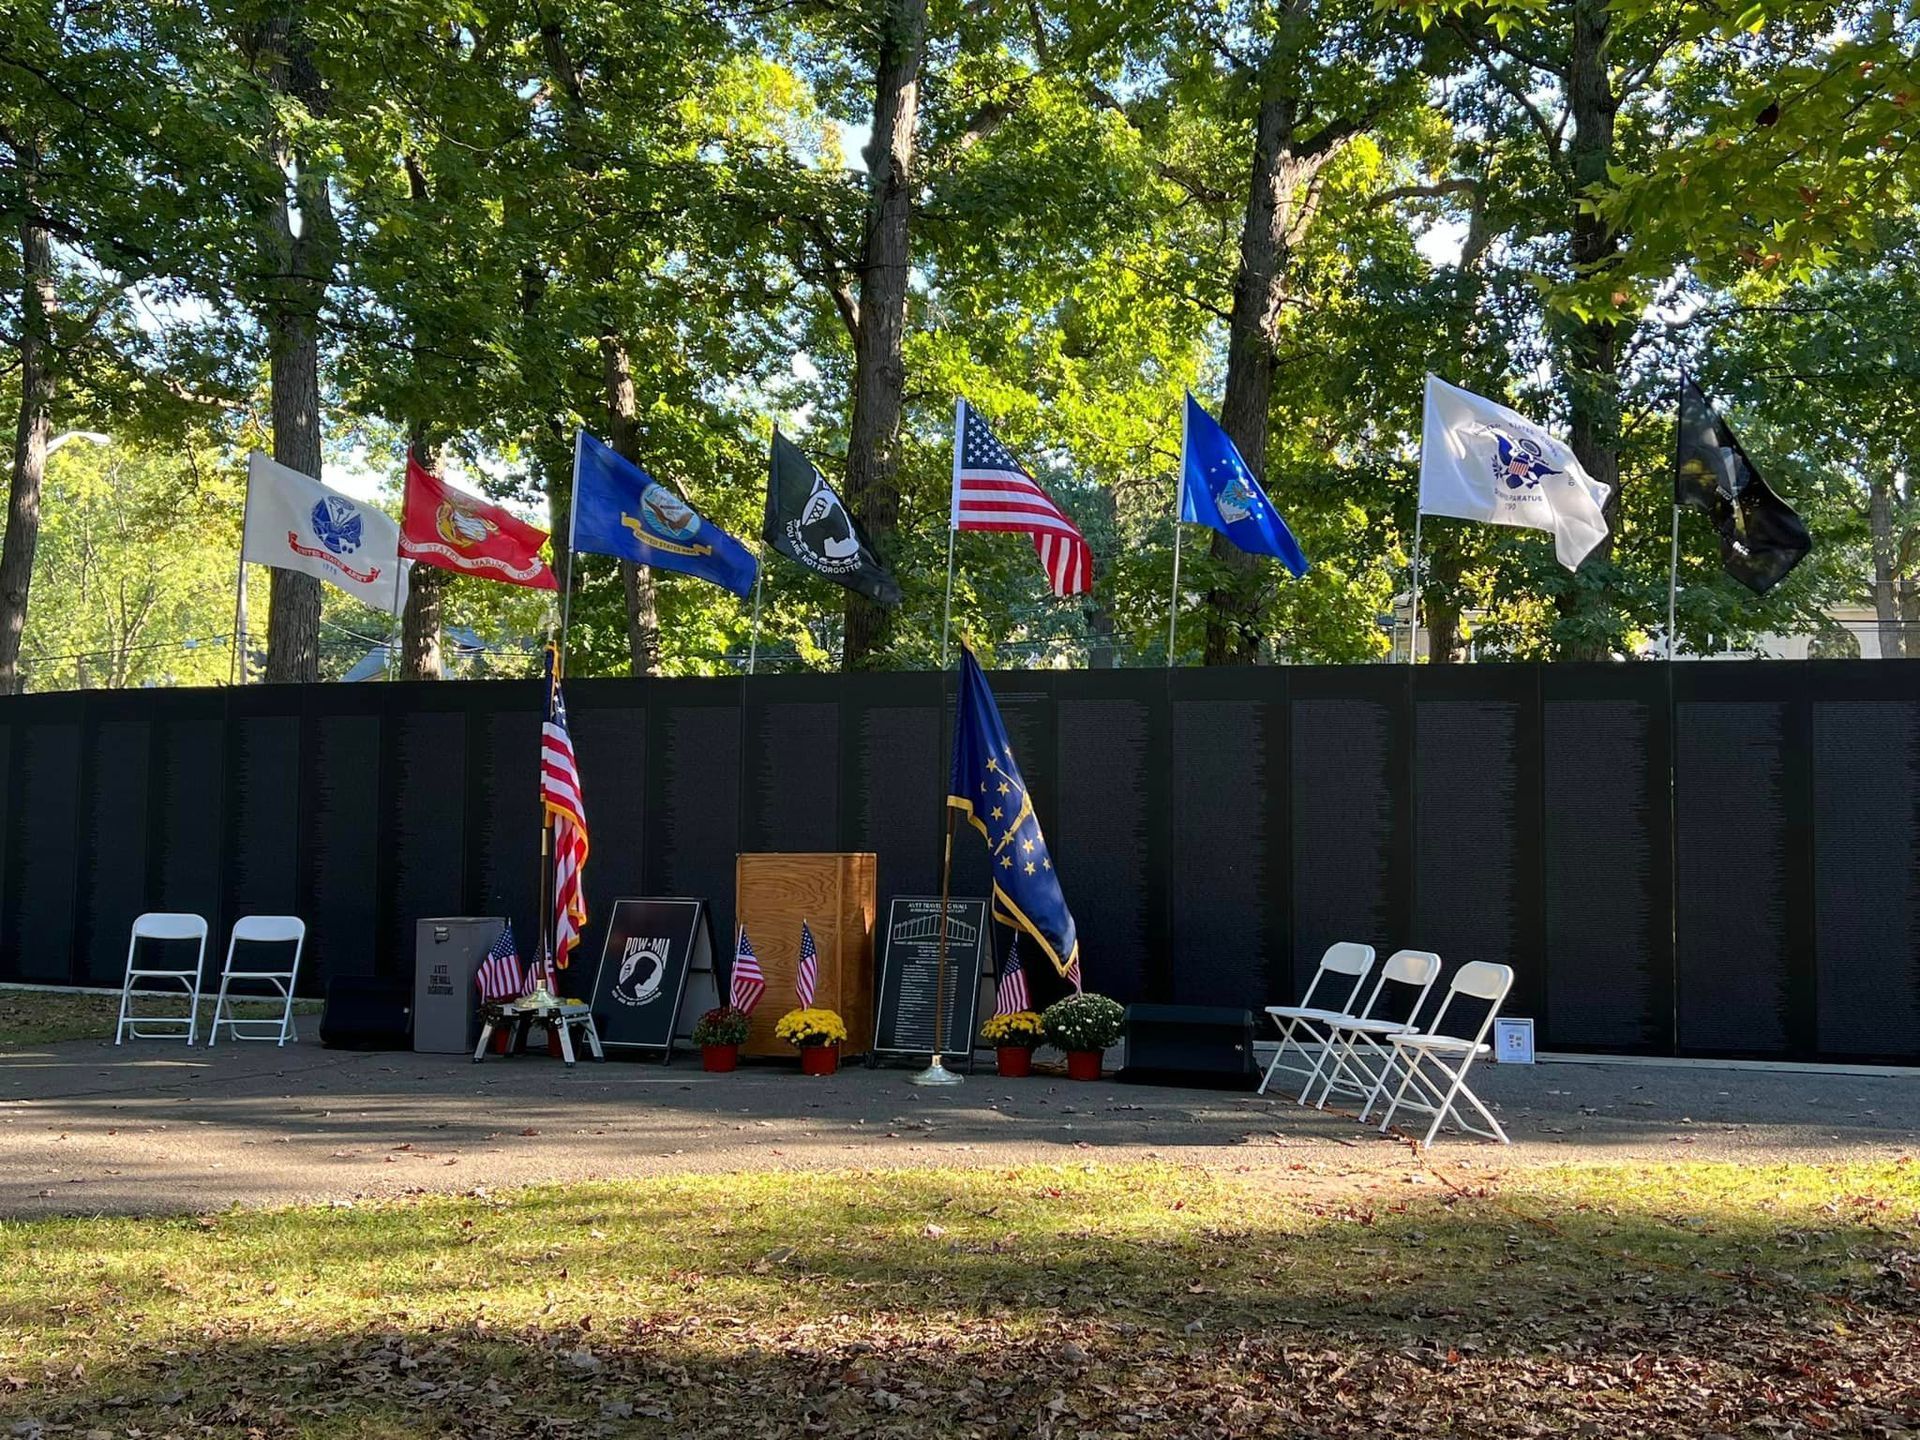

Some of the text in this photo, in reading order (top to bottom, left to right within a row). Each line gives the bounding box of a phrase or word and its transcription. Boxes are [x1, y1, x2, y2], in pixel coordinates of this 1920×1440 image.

[786, 520, 795, 538] YOU
[635, 530, 660, 546] UNITED
[659, 540, 681, 553] STATES
[790, 540, 803, 556] ARE
[427, 544, 459, 562] STATES
[471, 558, 508, 570] MARINE
[801, 554, 818, 568] NOT
